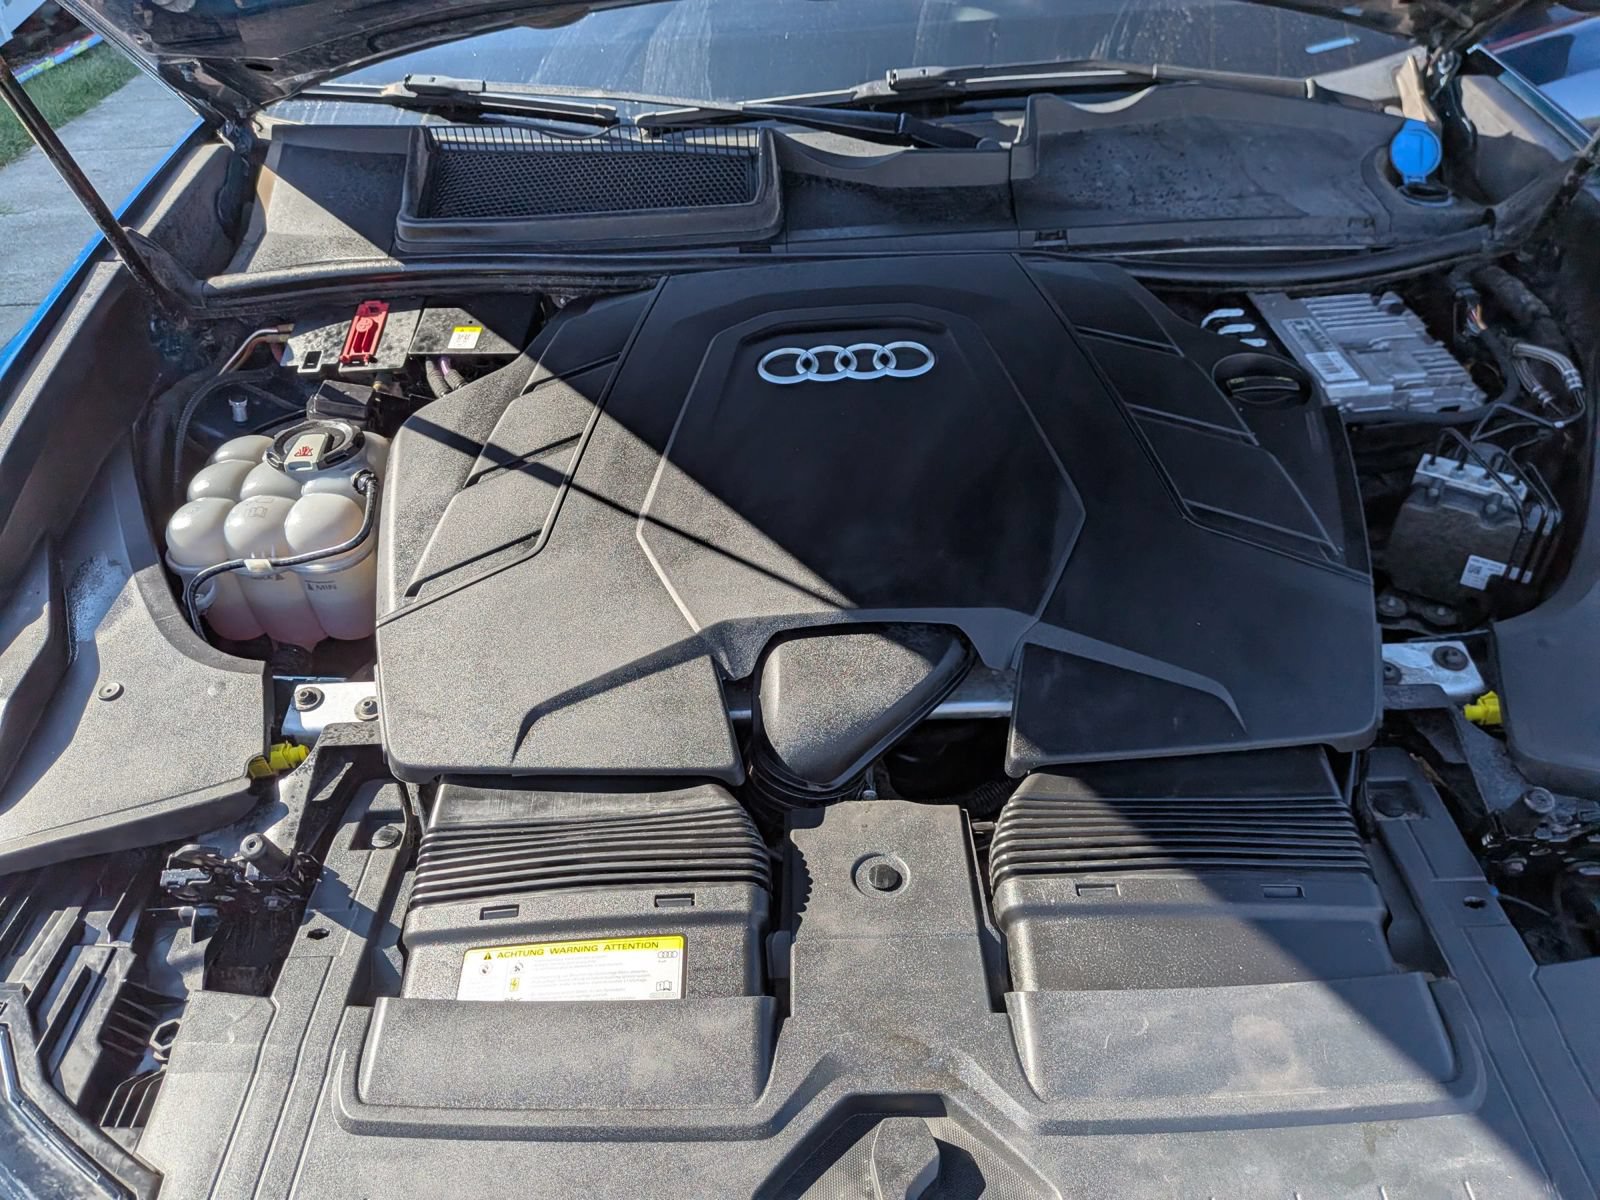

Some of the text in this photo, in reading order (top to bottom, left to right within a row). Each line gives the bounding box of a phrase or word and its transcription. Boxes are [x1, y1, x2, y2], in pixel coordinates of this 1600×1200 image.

[496, 941, 659, 959] ACHTUNG WARNING ATTENTION
